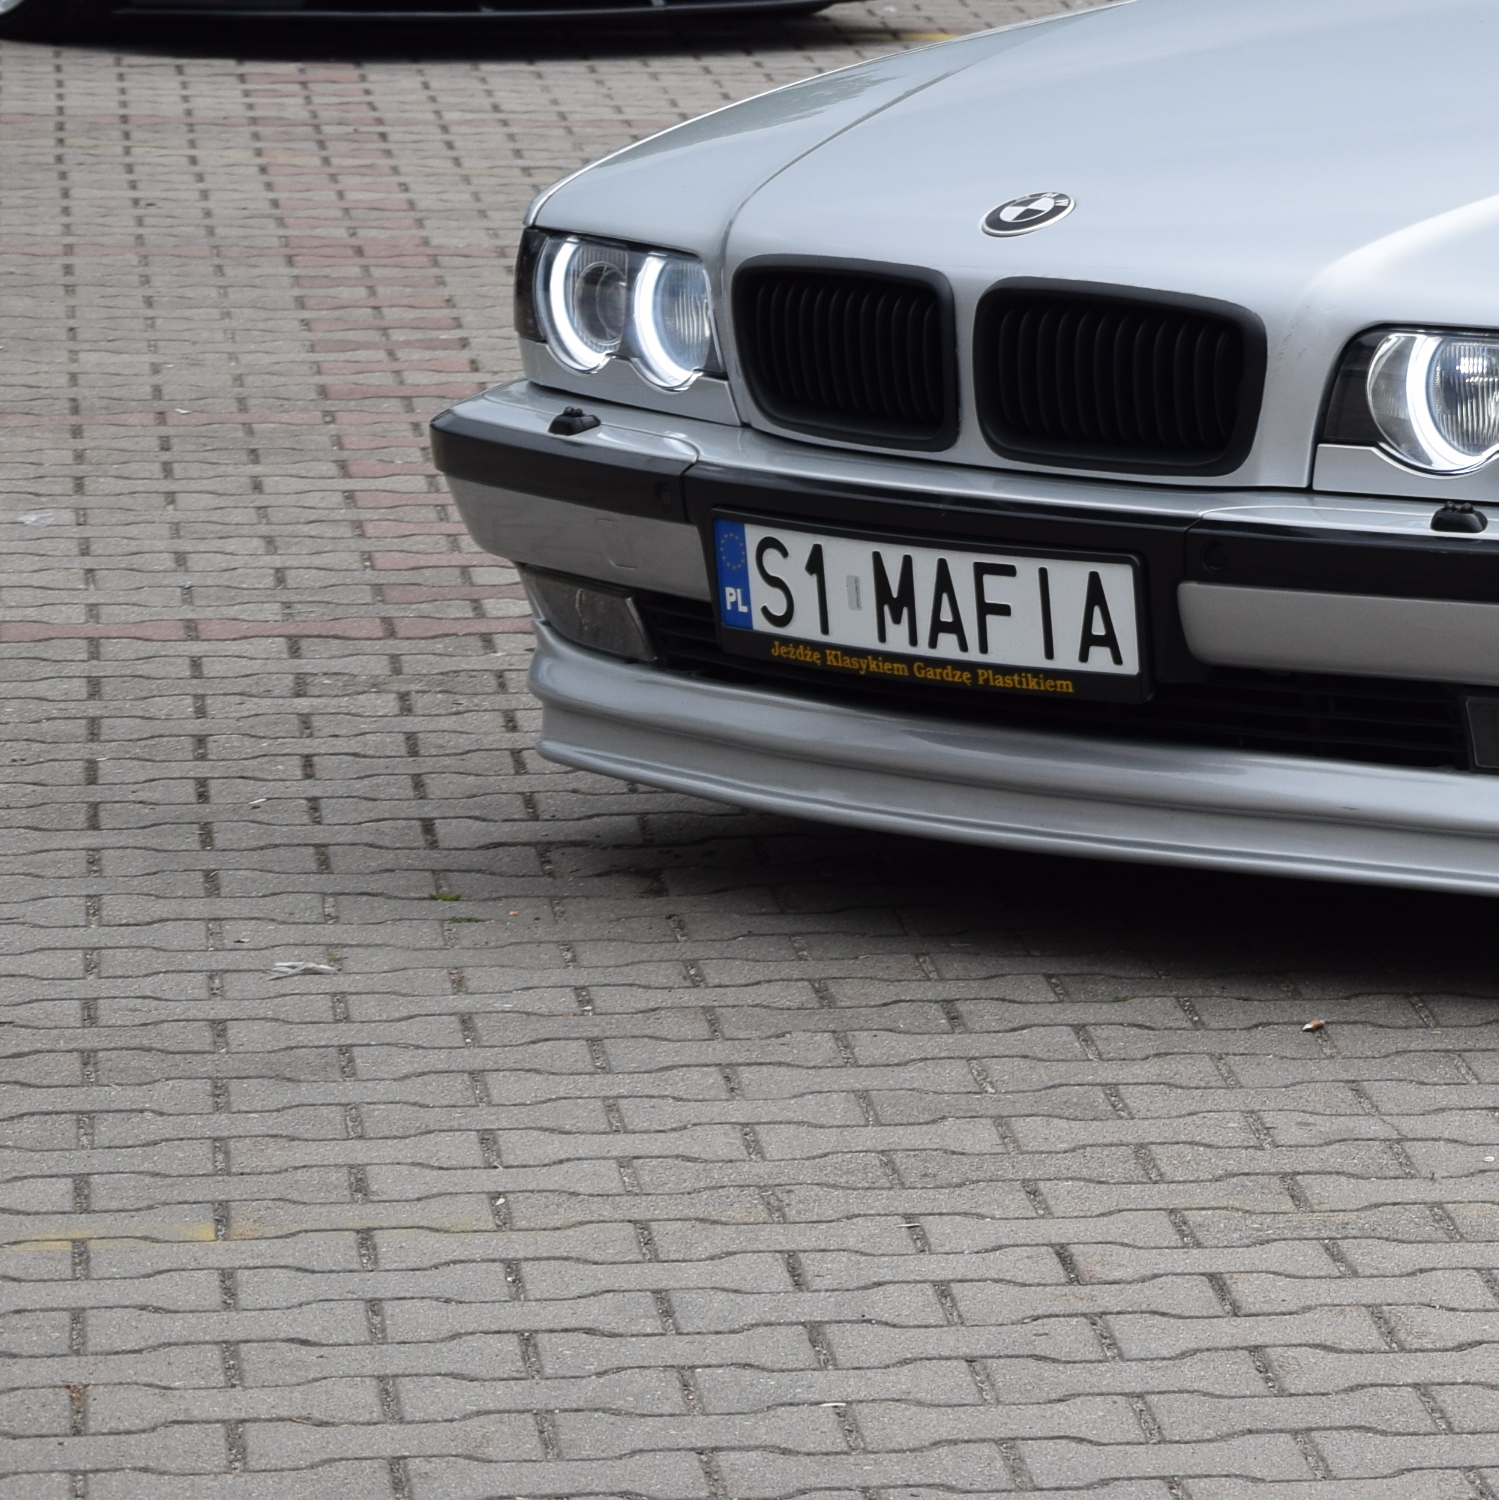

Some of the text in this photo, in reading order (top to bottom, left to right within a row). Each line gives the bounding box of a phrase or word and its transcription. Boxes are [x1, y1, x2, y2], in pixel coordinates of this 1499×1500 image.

[724, 586, 749, 614] PL
[755, 535, 1124, 666] S1 MAFIA
[771, 639, 1075, 694] Jeżdżę Klasykiem Gardzę Plastikiem
